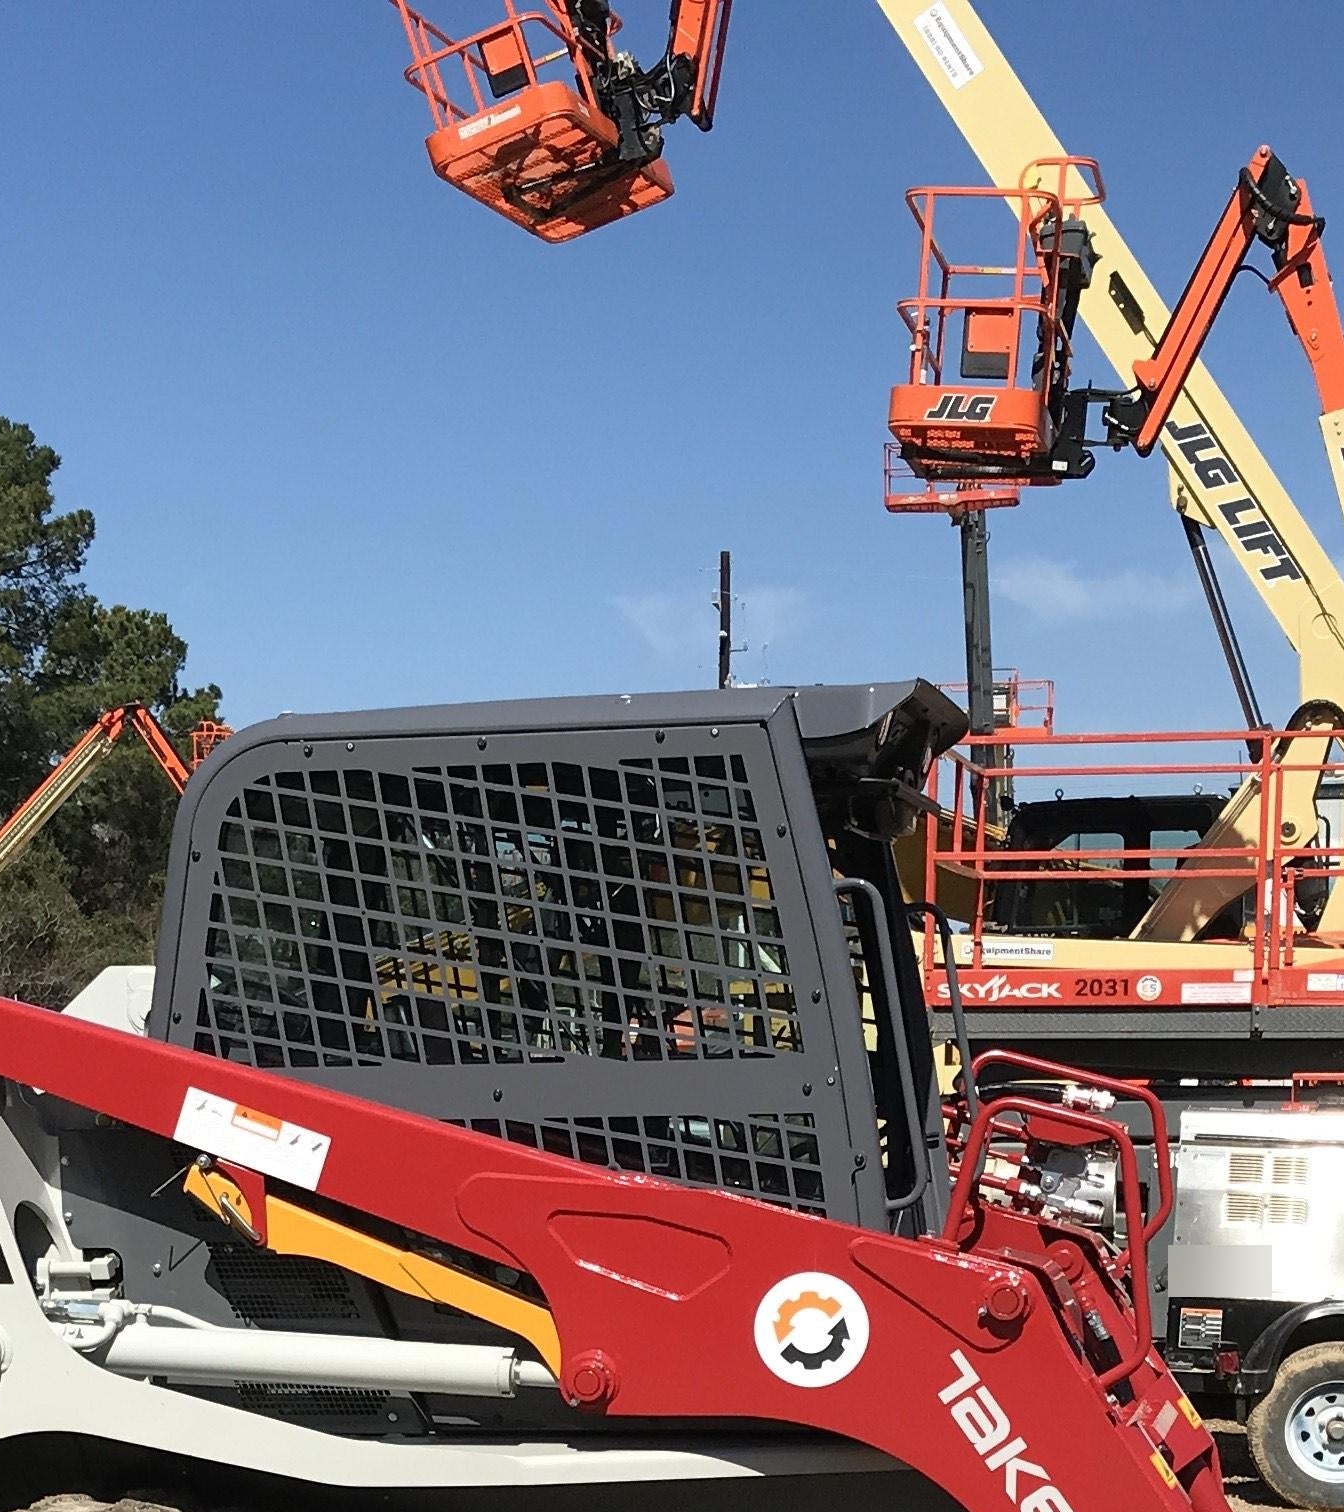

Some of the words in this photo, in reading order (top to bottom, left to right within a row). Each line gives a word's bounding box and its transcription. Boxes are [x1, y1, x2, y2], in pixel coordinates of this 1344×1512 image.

[925, 395, 997, 422] JLG
[1165, 420, 1240, 490] JLG
[1217, 497, 1302, 584] LIFT
[1074, 978, 1129, 997] 2031
